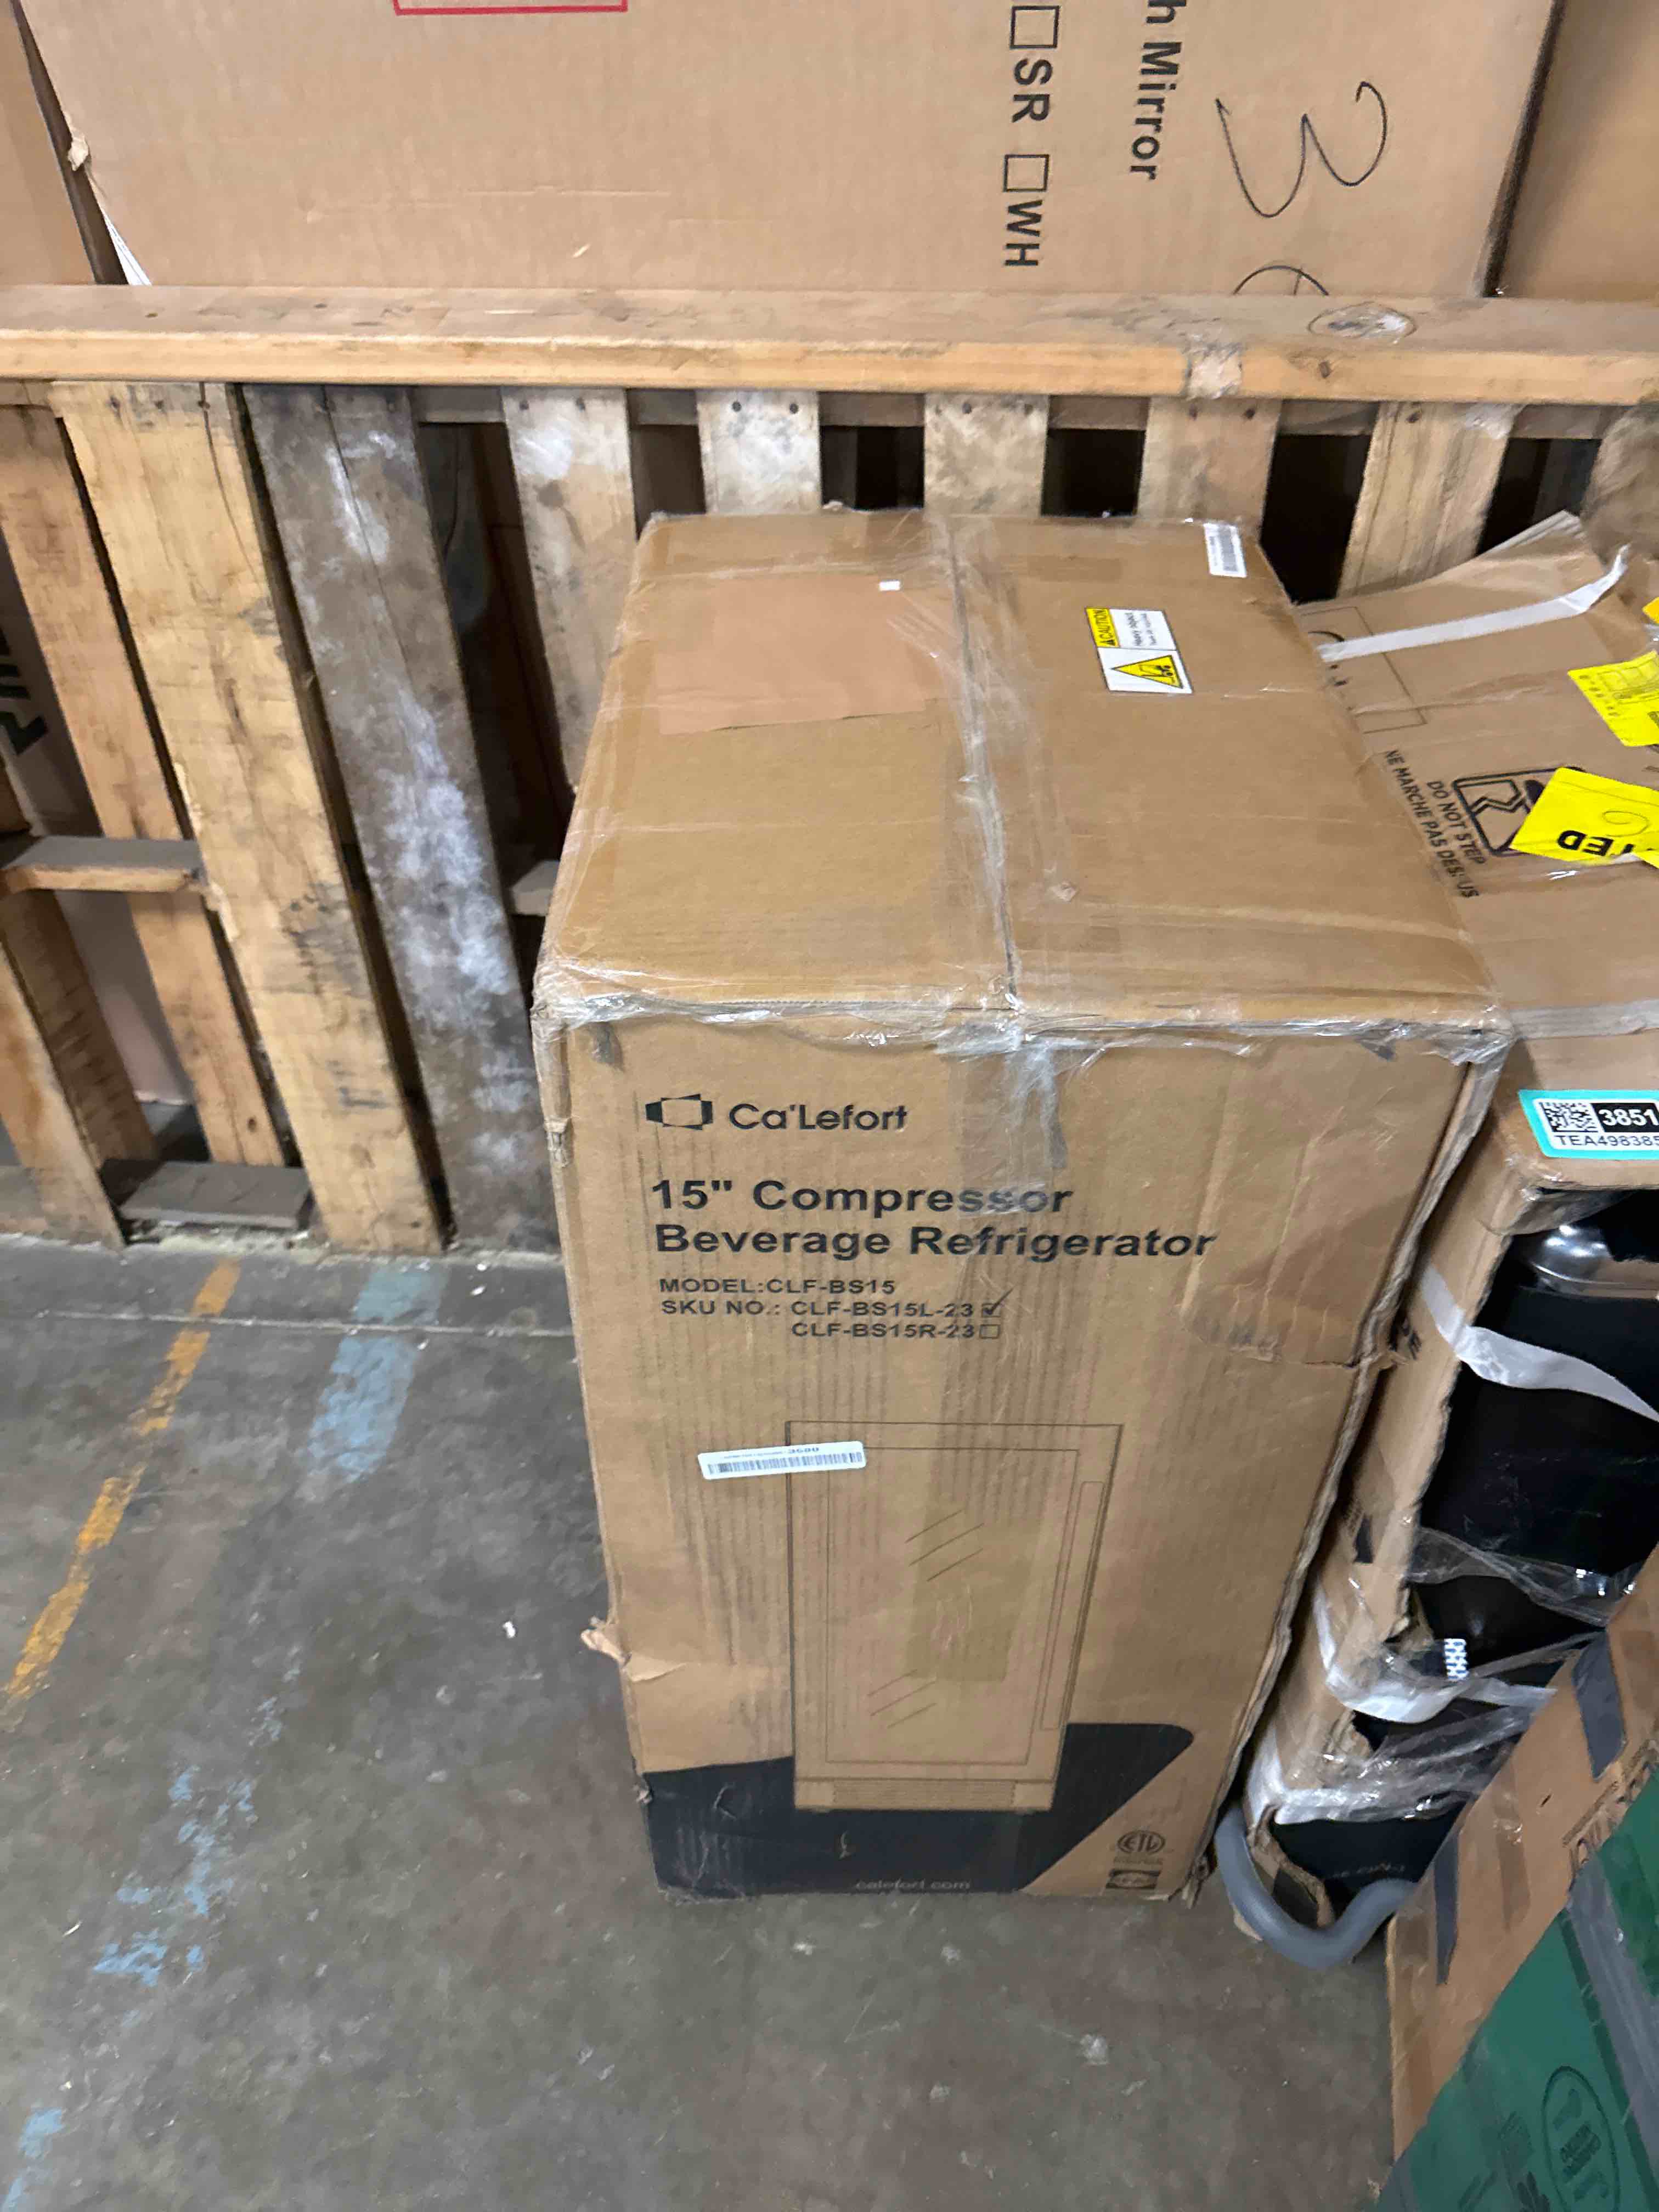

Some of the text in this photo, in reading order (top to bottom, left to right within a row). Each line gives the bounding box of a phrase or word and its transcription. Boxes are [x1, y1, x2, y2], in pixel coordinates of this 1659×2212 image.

[1131, 42, 1182, 180] Mirror
[1005, 58, 1053, 267] SR WH
[1093, 609, 1114, 641] CAUTION
[1385, 750, 1405, 765] NE
[1393, 768, 1432, 817] MARCHE
[1420, 821, 1448, 847] PAS
[1426, 781, 1486, 864] DO NOT STEP
[729, 1103, 908, 1130] Ca'Lefort
[1598, 1108, 1659, 1126] 3851
[652, 1180, 1074, 1218] 15" Compressor
[656, 1223, 1218, 1262] Beverage Refrigerator
[662, 1300, 715, 1315] SKU
[791, 1301, 974, 1317] CLF-BS15L-23
[792, 1322, 975, 1339] CLF-BS15R-23
